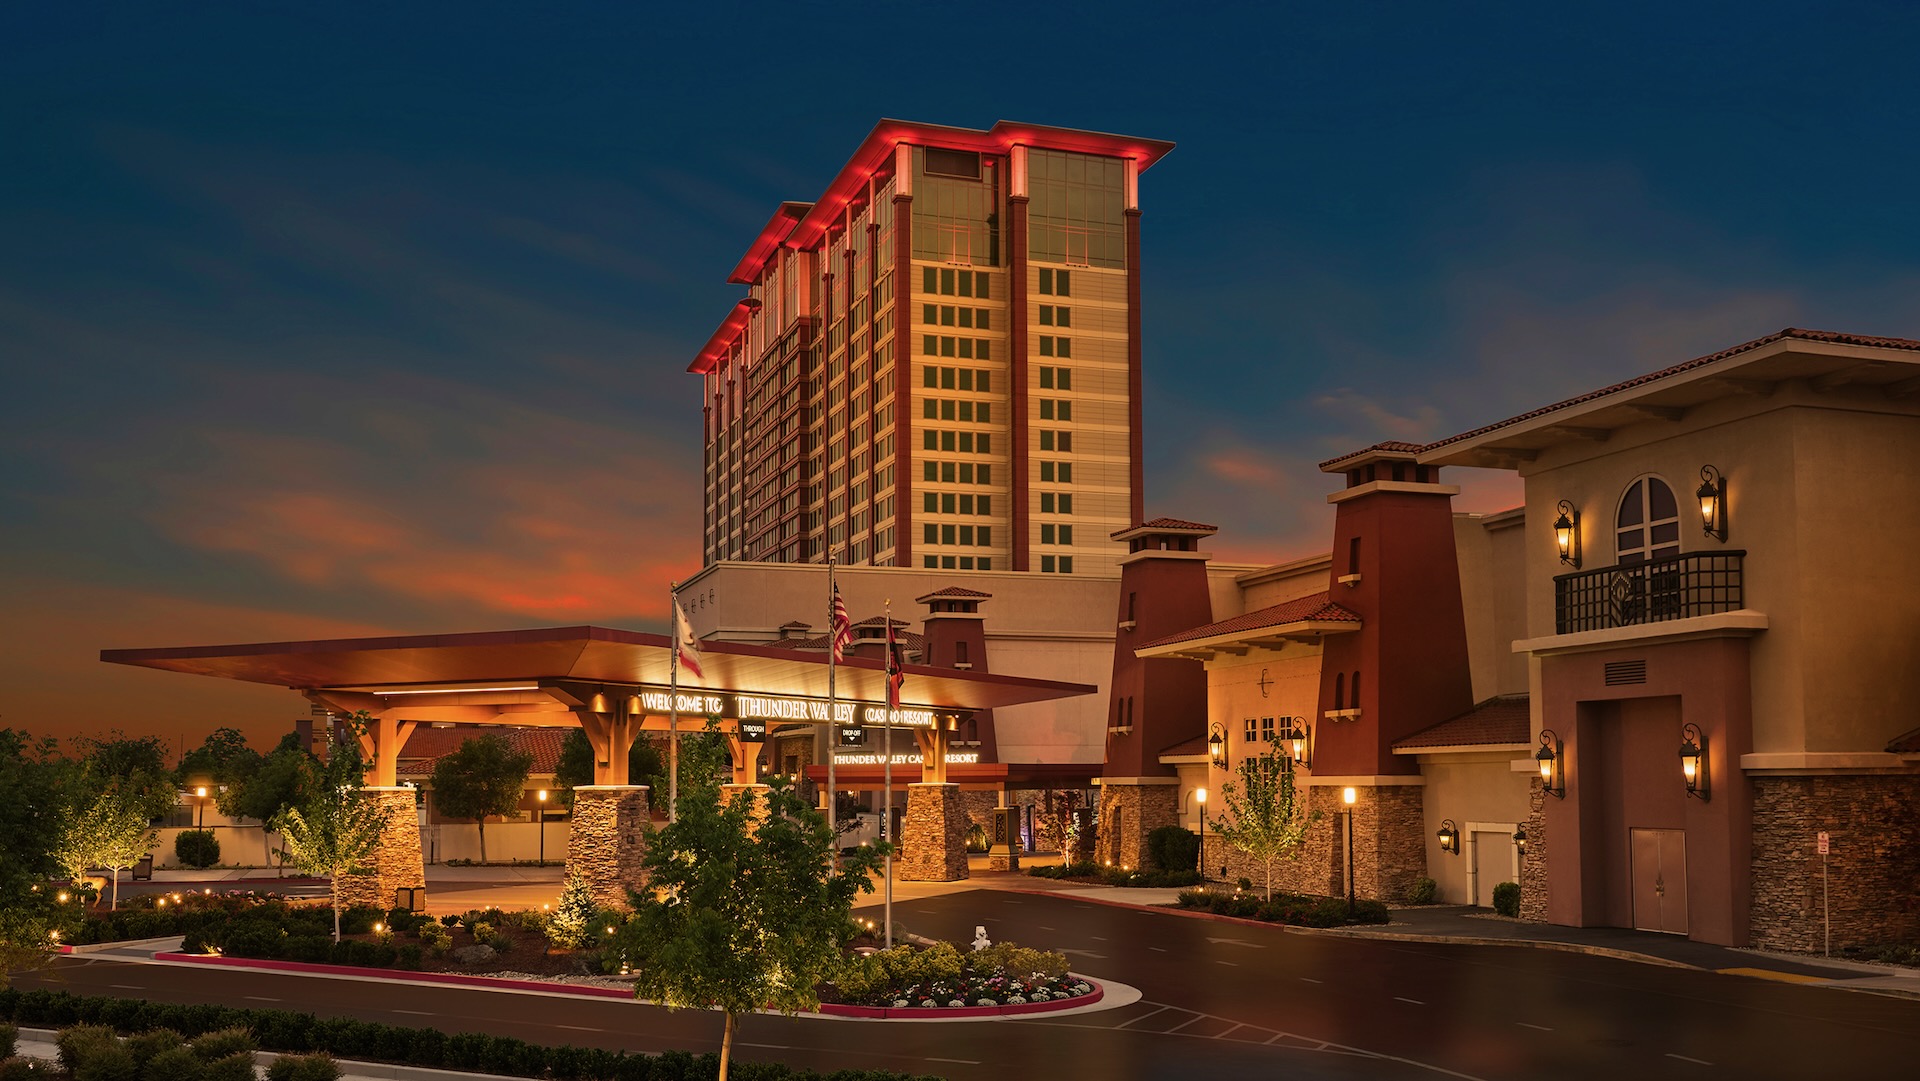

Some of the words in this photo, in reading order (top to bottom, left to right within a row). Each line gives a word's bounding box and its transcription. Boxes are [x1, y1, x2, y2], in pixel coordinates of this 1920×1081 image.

[642, 692, 703, 713] WELOME
[703, 696, 723, 714] TO
[735, 695, 809, 719] THUNDER
[809, 702, 857, 724] VALEY
[865, 707, 900, 724] CASIO
[900, 709, 934, 726] RESORT
[743, 724, 765, 733] THROUGH
[834, 754, 876, 765] THUNDER
[944, 753, 979, 764] RESORT
